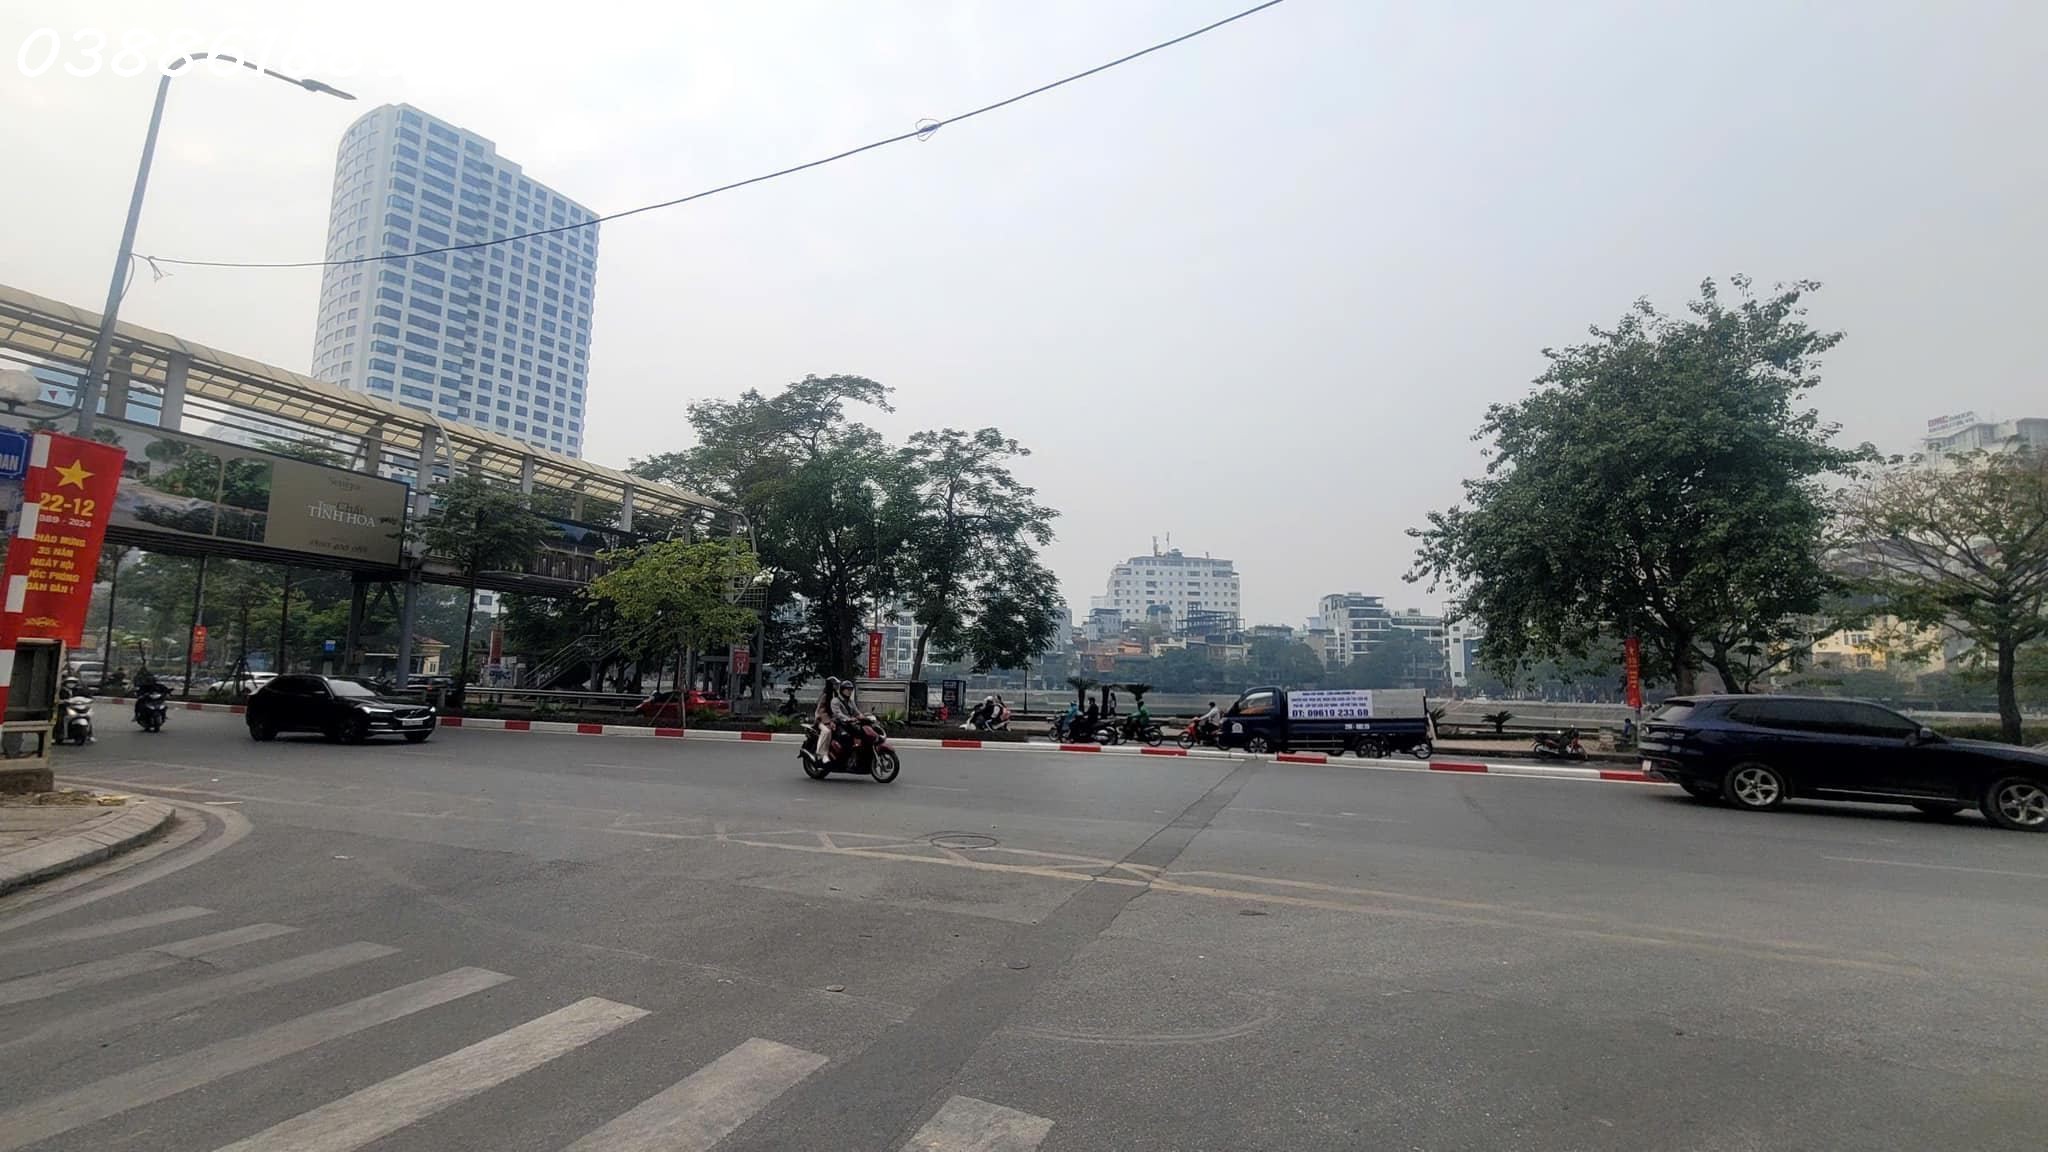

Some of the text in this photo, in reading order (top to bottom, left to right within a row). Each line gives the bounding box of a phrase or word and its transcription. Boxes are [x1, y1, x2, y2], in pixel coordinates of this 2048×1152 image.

[39, 492, 95, 517] 22-12
[68, 518, 92, 528] 2024
[346, 512, 376, 528] HOA
[1338, 709, 1354, 717] 233
